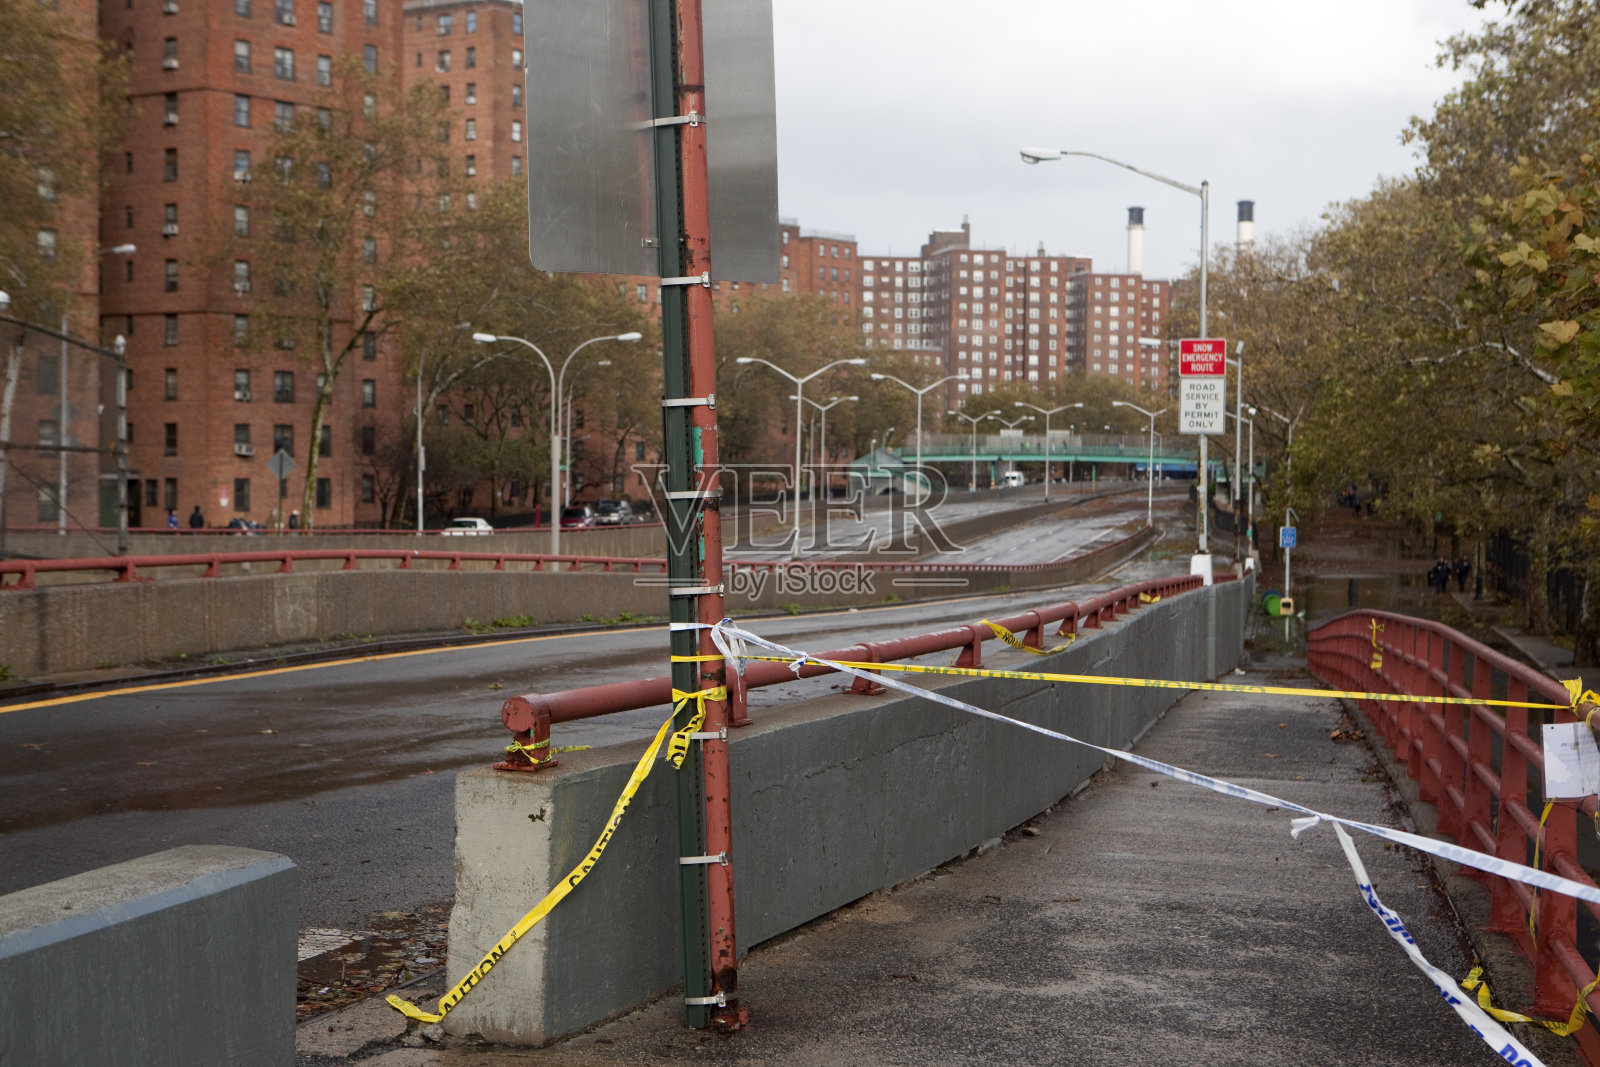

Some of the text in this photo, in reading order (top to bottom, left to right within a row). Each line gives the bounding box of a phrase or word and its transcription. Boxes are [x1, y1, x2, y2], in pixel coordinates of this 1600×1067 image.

[1193, 343, 1213, 352] SNOW
[1182, 353, 1223, 362] EMERGENCY
[1191, 363, 1214, 372] ROUTE
[1189, 383, 1215, 391] ROAD
[1184, 411, 1219, 419] PERMIT
[440, 944, 505, 1016] AUTION
